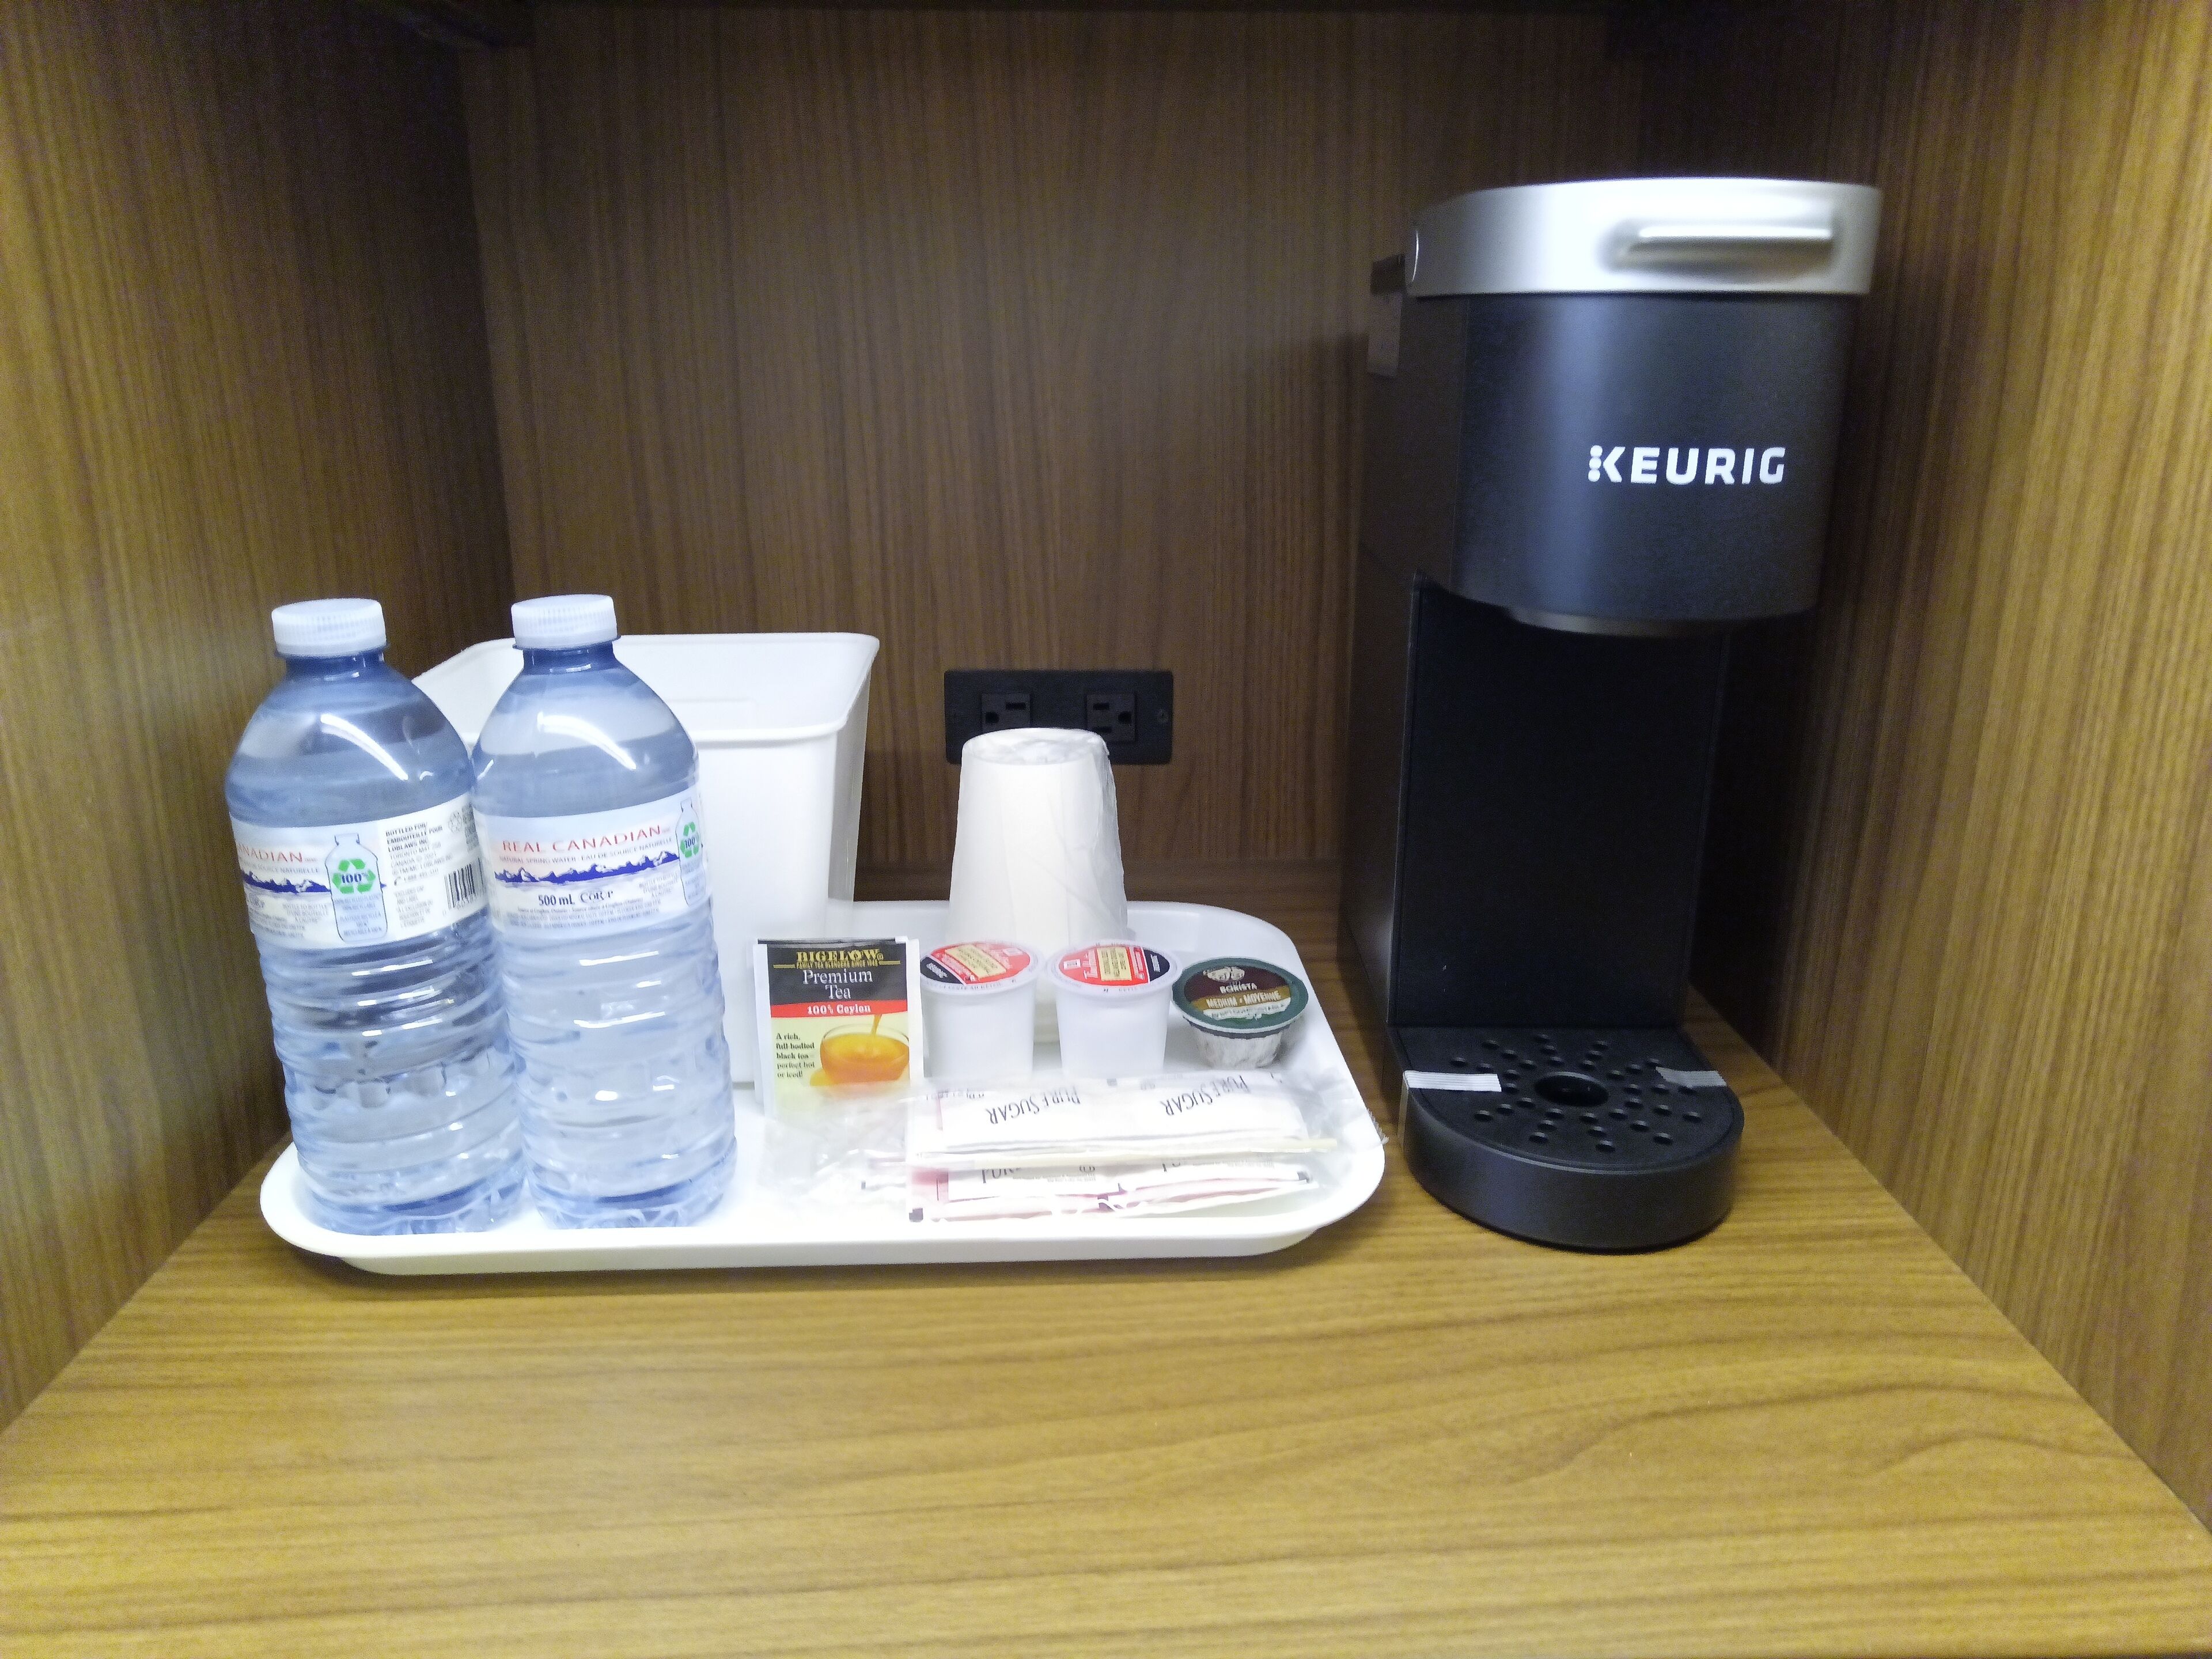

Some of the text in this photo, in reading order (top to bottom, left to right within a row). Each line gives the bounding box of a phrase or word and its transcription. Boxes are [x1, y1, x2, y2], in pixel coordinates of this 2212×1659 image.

[1588, 445, 1785, 485] KEURIG
[502, 825, 661, 853] REAL CANADIAN
[237, 843, 303, 863] ANADIAN
[538, 893, 556, 906] 500
[796, 949, 880, 962] BIGELOW
[802, 968, 873, 984] Premium
[825, 984, 851, 999] Tea
[807, 1003, 871, 1015] 100% Ceylon
[1206, 996, 1237, 1008] MEDIUM
[1160, 1082, 1213, 1116] SUGAR
[985, 1094, 1040, 1124] SUGAR
